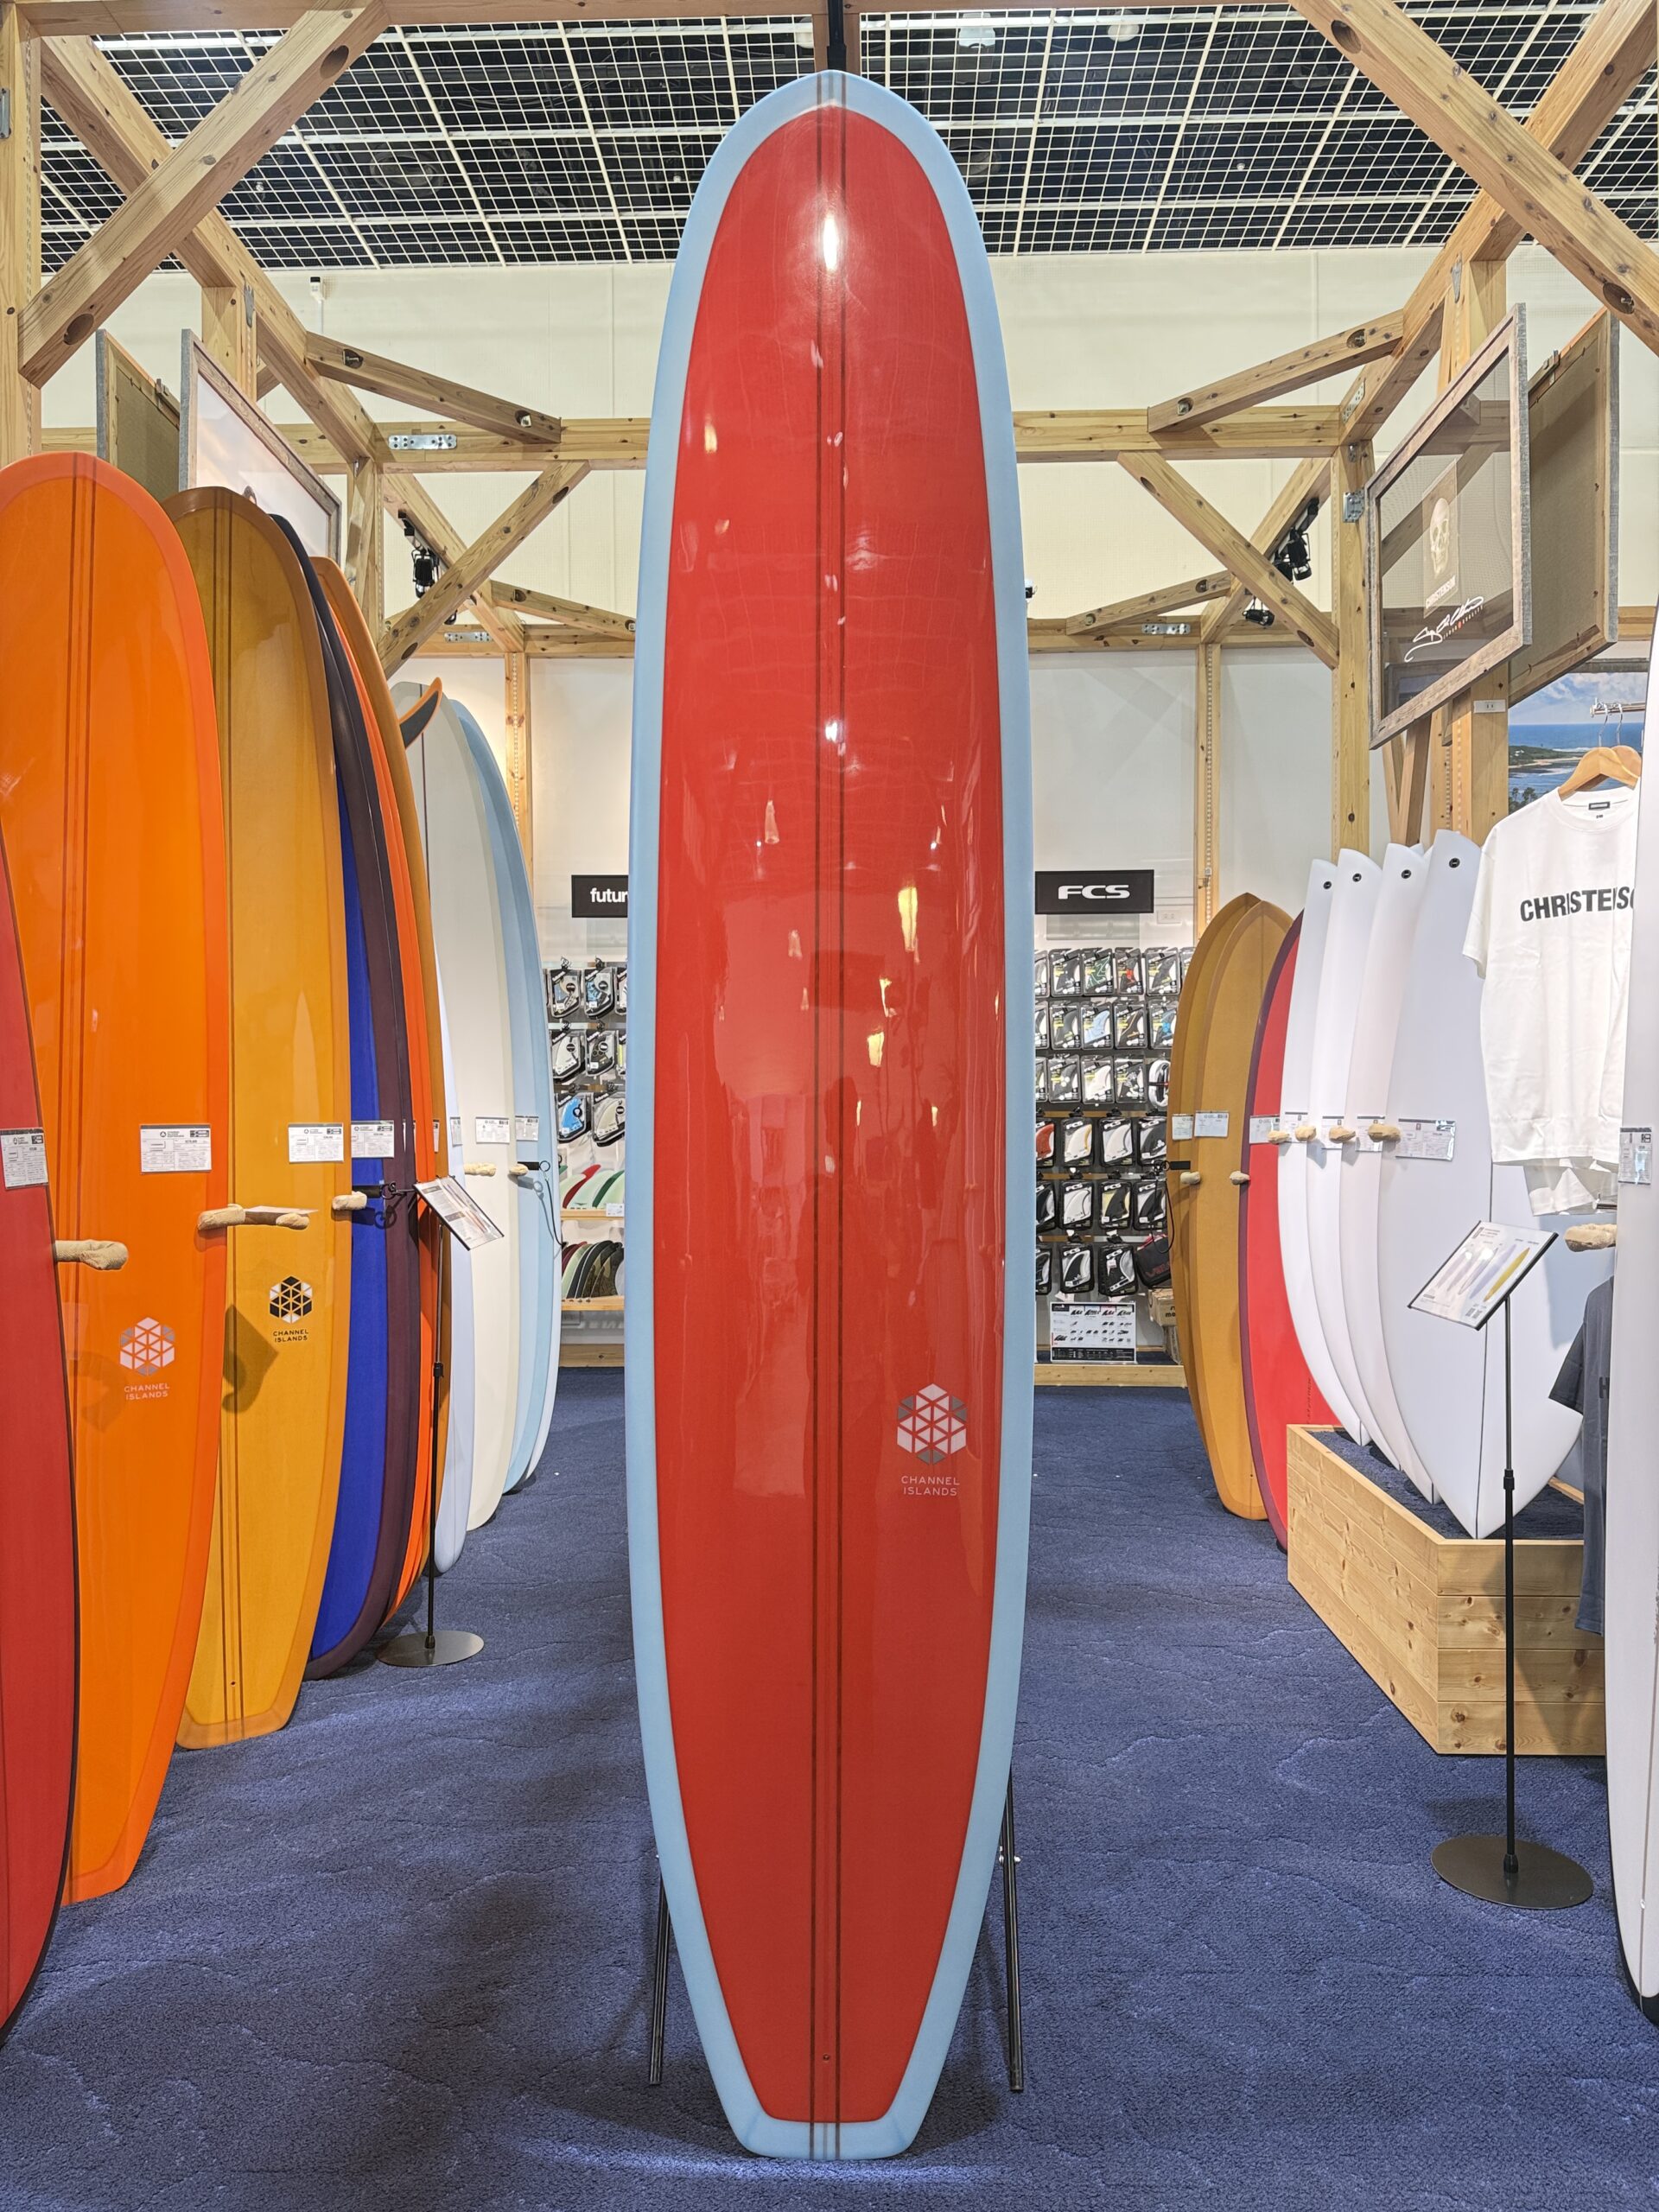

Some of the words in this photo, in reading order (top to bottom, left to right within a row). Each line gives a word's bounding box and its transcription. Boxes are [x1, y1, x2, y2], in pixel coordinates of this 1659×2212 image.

[1058, 885, 1130, 899] FCS
[1520, 886, 1635, 922] CHRISTES
[1065, 1121, 1084, 1130] FCS
[1103, 1120, 1122, 1129] FCS
[1065, 1183, 1084, 1192] FCS
[1103, 1183, 1122, 1192] FCS
[1139, 1183, 1157, 1192] FCS
[124, 1382, 170, 1393] CHANNEL
[125, 1390, 168, 1401] ISLANDS
[900, 1475, 960, 1485] CHANNEL
[903, 1486, 957, 1497] ISLANDS
